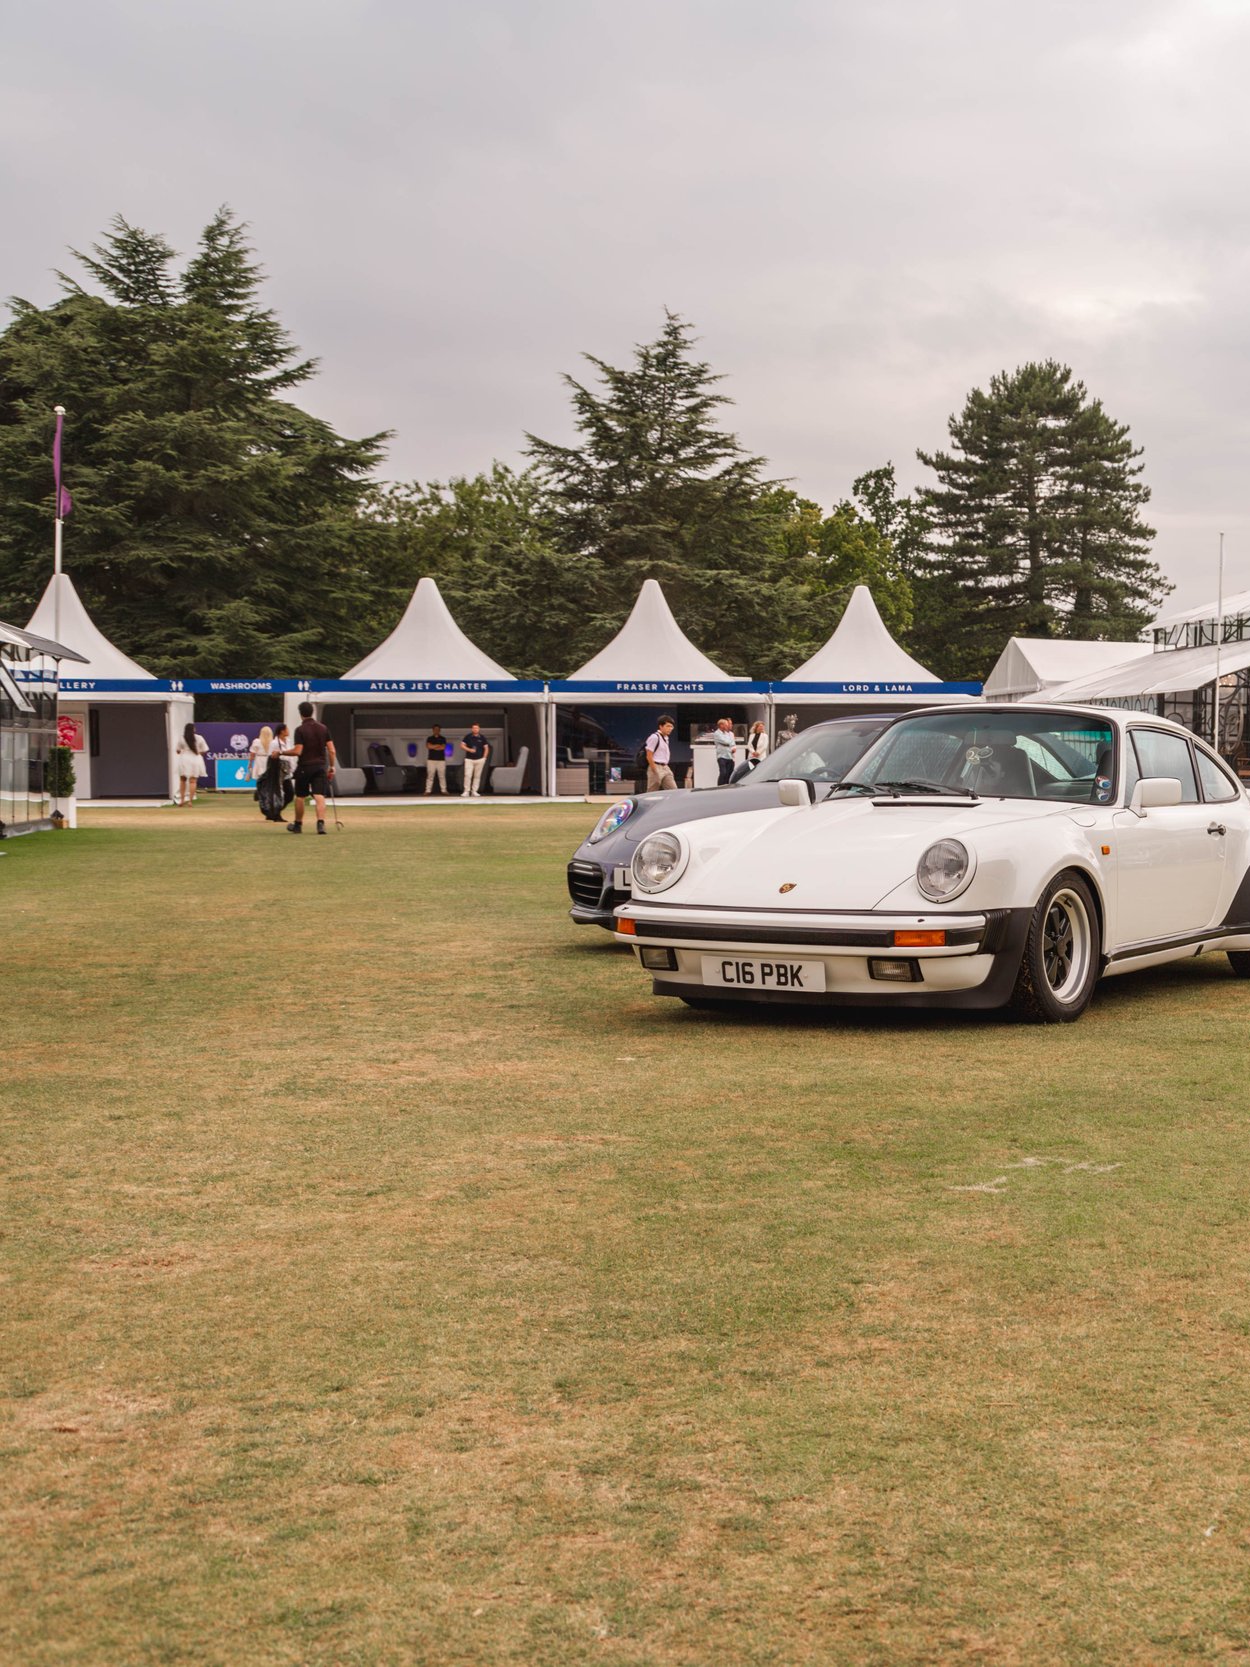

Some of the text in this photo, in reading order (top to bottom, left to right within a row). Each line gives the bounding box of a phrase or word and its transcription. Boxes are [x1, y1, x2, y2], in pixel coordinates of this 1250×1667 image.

[210, 682, 272, 690] WASHROOMS
[370, 682, 488, 690] ATLAS JET CHARTER
[616, 683, 704, 691] FRASER YACHTS
[842, 684, 913, 692] LORD & LAMA
[721, 960, 804, 988] C16 PBK
